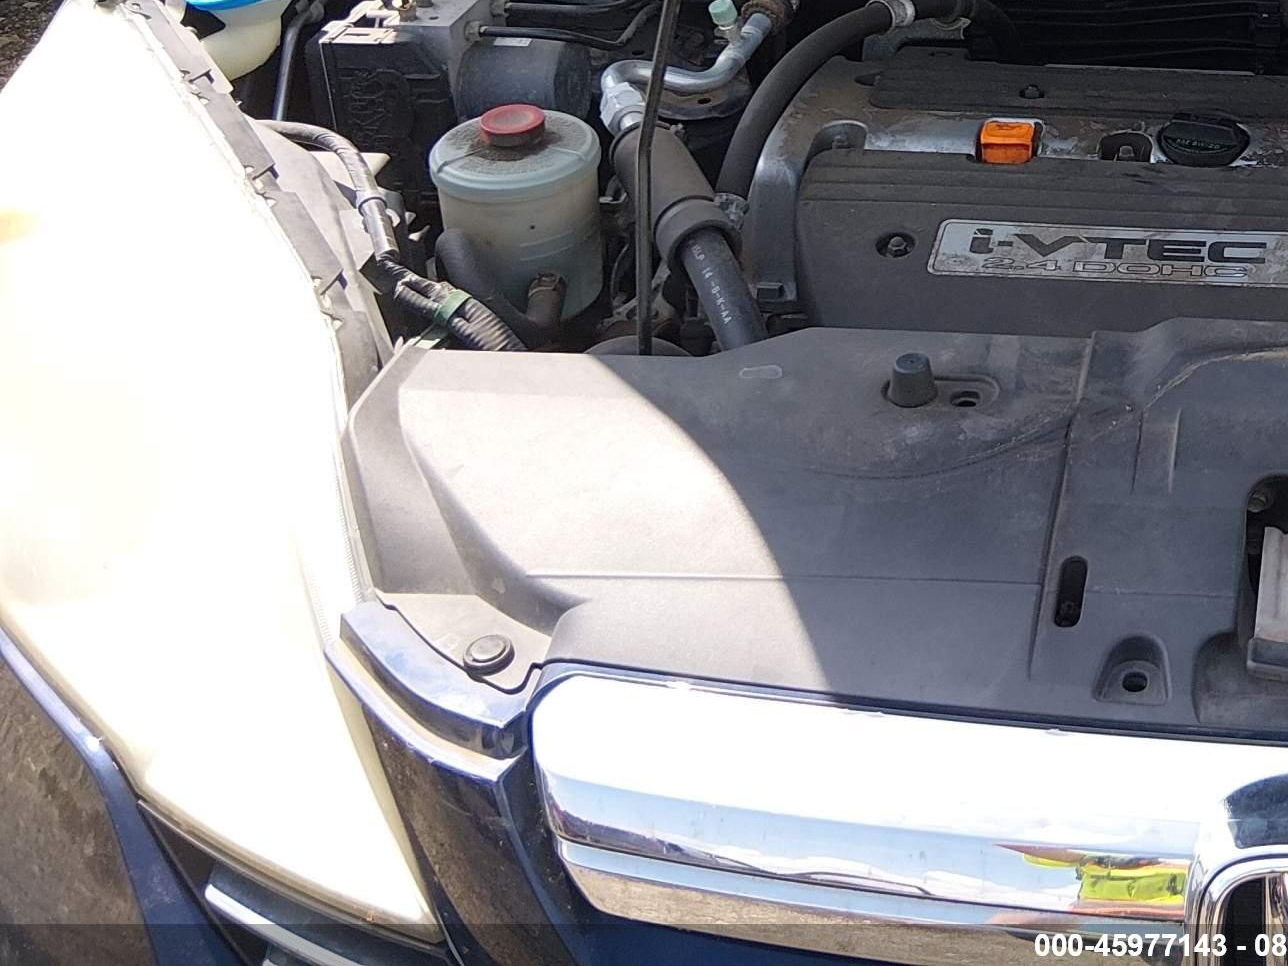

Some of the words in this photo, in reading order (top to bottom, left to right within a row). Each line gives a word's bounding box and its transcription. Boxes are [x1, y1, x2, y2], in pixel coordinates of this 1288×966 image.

[969, 228, 1268, 264] i-VTEC
[982, 257, 1060, 272] 2.4
[1072, 260, 1248, 278] DOHC
